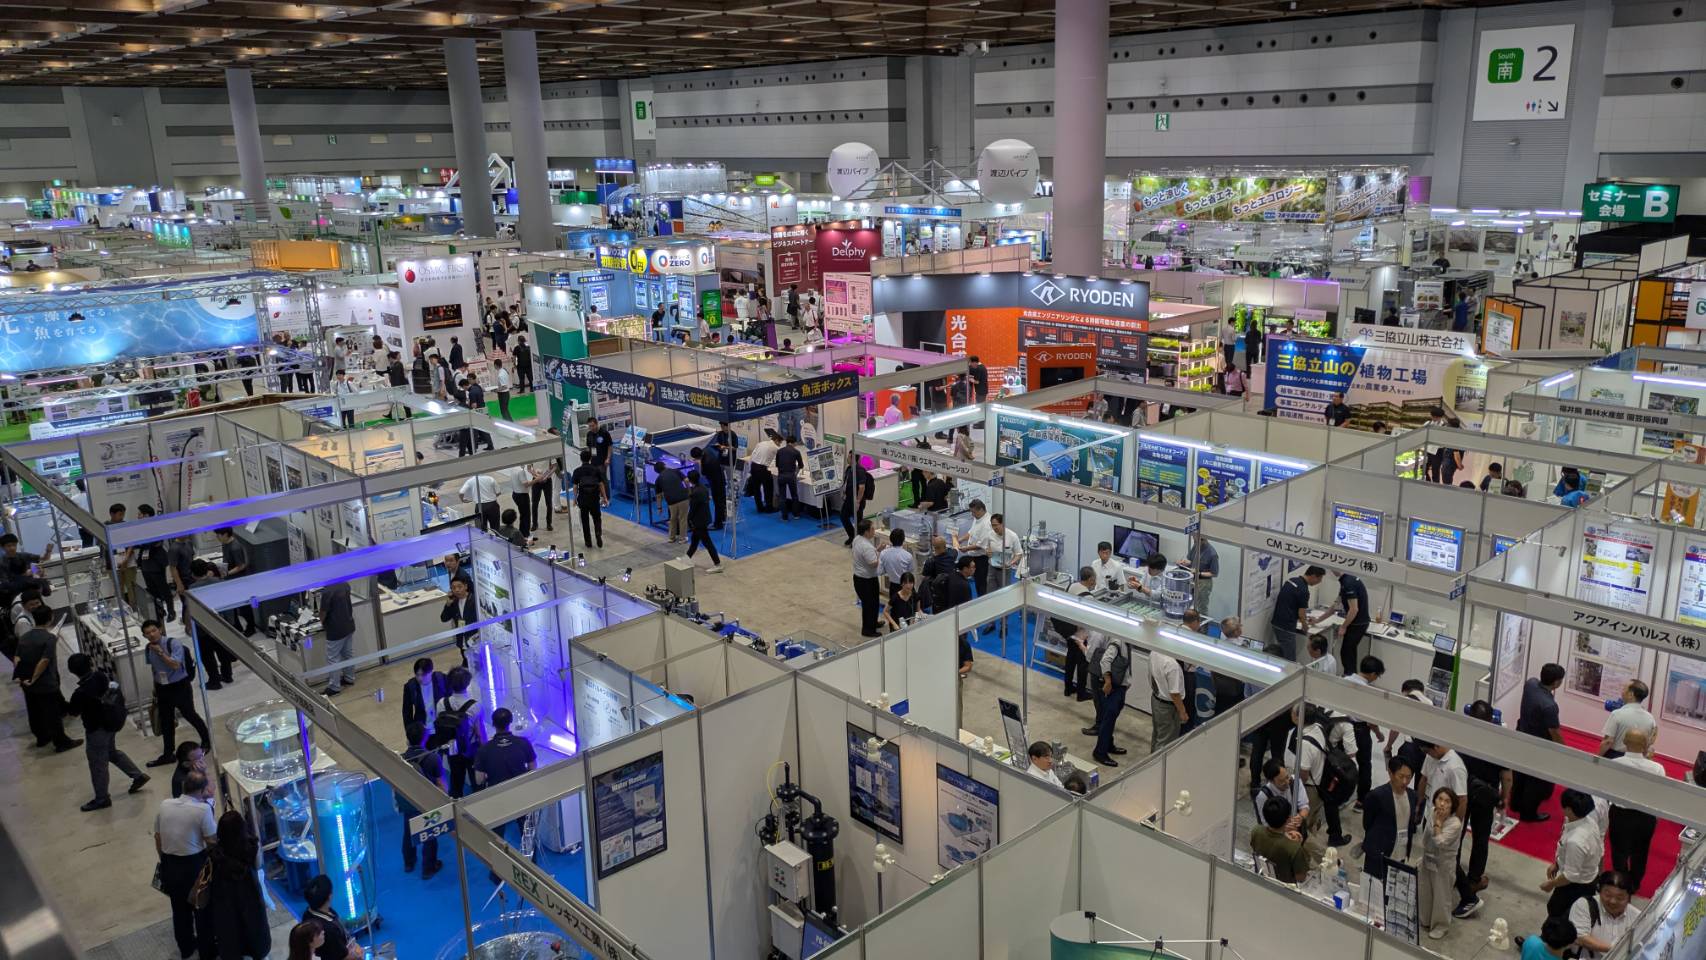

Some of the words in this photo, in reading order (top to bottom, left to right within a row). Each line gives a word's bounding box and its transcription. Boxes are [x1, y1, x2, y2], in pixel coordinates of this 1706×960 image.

[1497, 52, 1516, 60] South
[1532, 45, 1558, 82] 2
[1497, 61, 1513, 80] 南
[1143, 182, 1190, 207] もっと涼しく
[1184, 186, 1234, 212] もっと省エネ
[1232, 185, 1304, 214] もっとエコロジー
[1587, 189, 1641, 203] セミナー
[1643, 190, 1670, 218] B
[1599, 204, 1625, 218] 会場
[773, 239, 814, 249] ビジネスパートナー
[832, 246, 866, 258] Delphy
[1069, 287, 1135, 308] RYODEN
[1375, 329, 1465, 350] 三協立山株式会社
[1056, 352, 1092, 360] RYODEN
[1276, 353, 1356, 377] 三協立山の
[1360, 362, 1428, 385] 植物工場
[735, 388, 800, 411] 活魚の出荷なら
[801, 376, 853, 398] 魚活ボックス
[1265, 537, 1283, 550] CM
[1285, 542, 1379, 573] エンジニアリング(株)
[418, 823, 449, 843] B-34
[511, 863, 541, 898] REX
